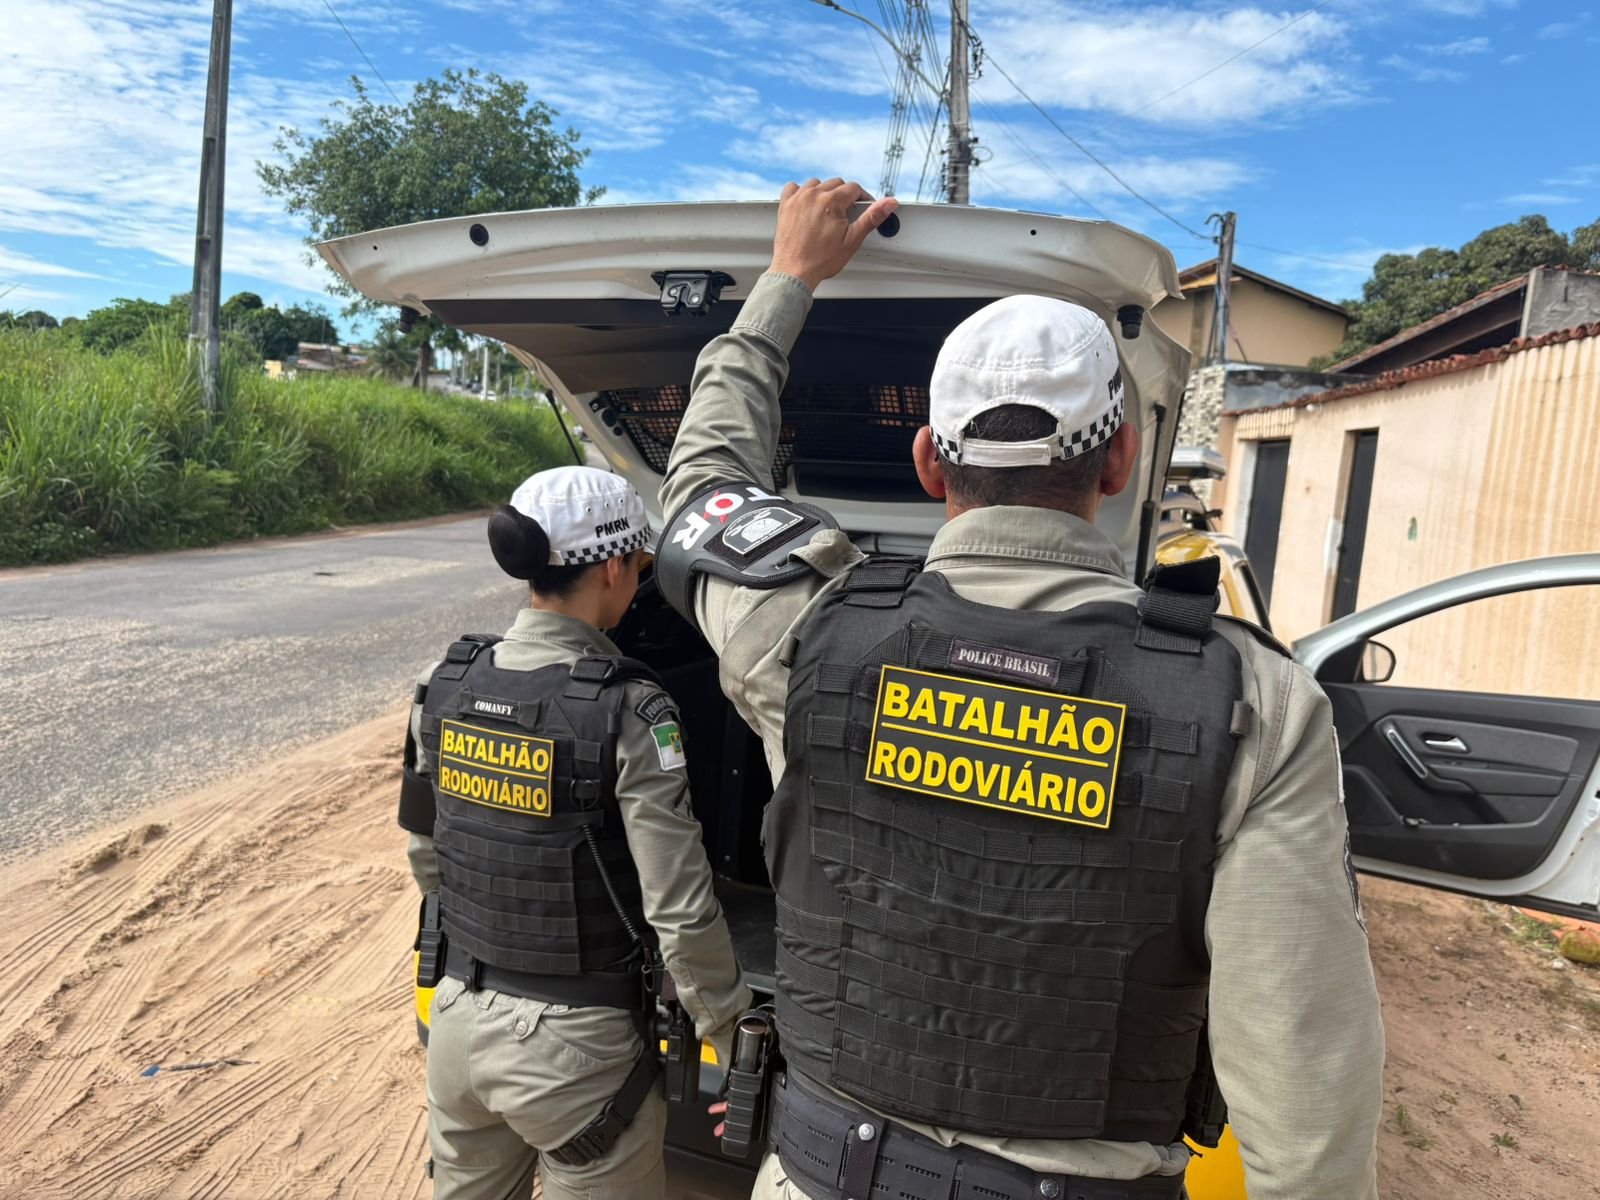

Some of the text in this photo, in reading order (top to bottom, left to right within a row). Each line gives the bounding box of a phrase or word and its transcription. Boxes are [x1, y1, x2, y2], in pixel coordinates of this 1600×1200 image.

[595, 517, 631, 538] PMRN
[958, 648, 1050, 677] POLICE BRASIL
[882, 681, 1115, 755] BATALHÃO
[443, 729, 549, 772] BATALHÃO
[441, 766, 547, 811] RODOVIÁRIO
[873, 741, 1106, 818] RODOVIÁRIO
